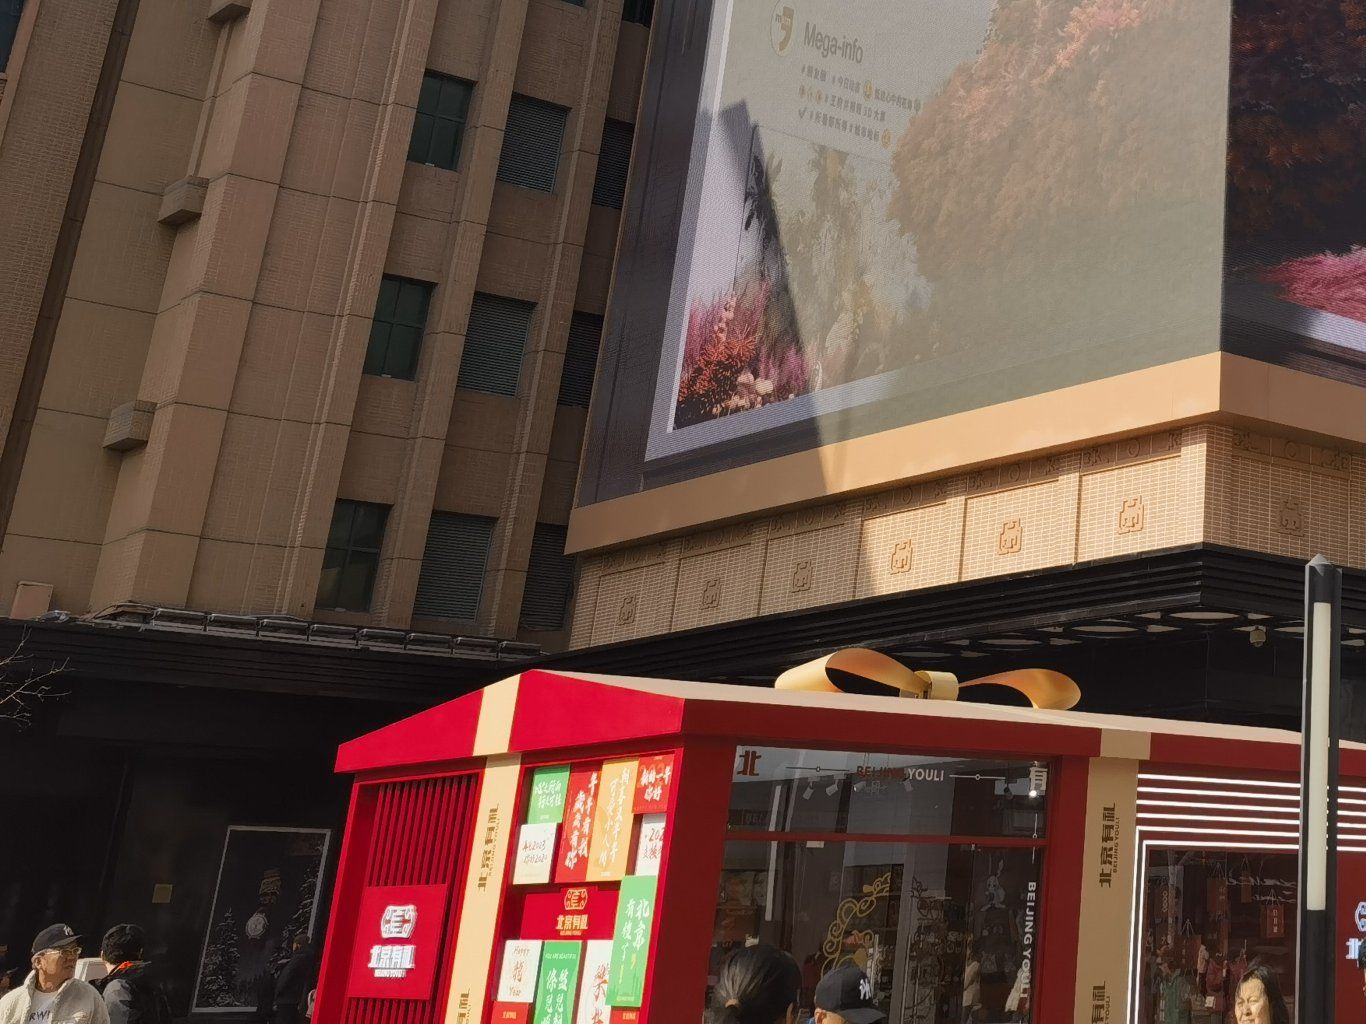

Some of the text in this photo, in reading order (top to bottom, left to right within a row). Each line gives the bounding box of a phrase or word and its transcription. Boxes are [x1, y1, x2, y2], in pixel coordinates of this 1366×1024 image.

[803, 21, 864, 64] Mega-info
[908, 767, 945, 782] YOULI
[1098, 800, 1116, 889] 北京有礼
[1019, 881, 1037, 998] BEIJING YOULI
